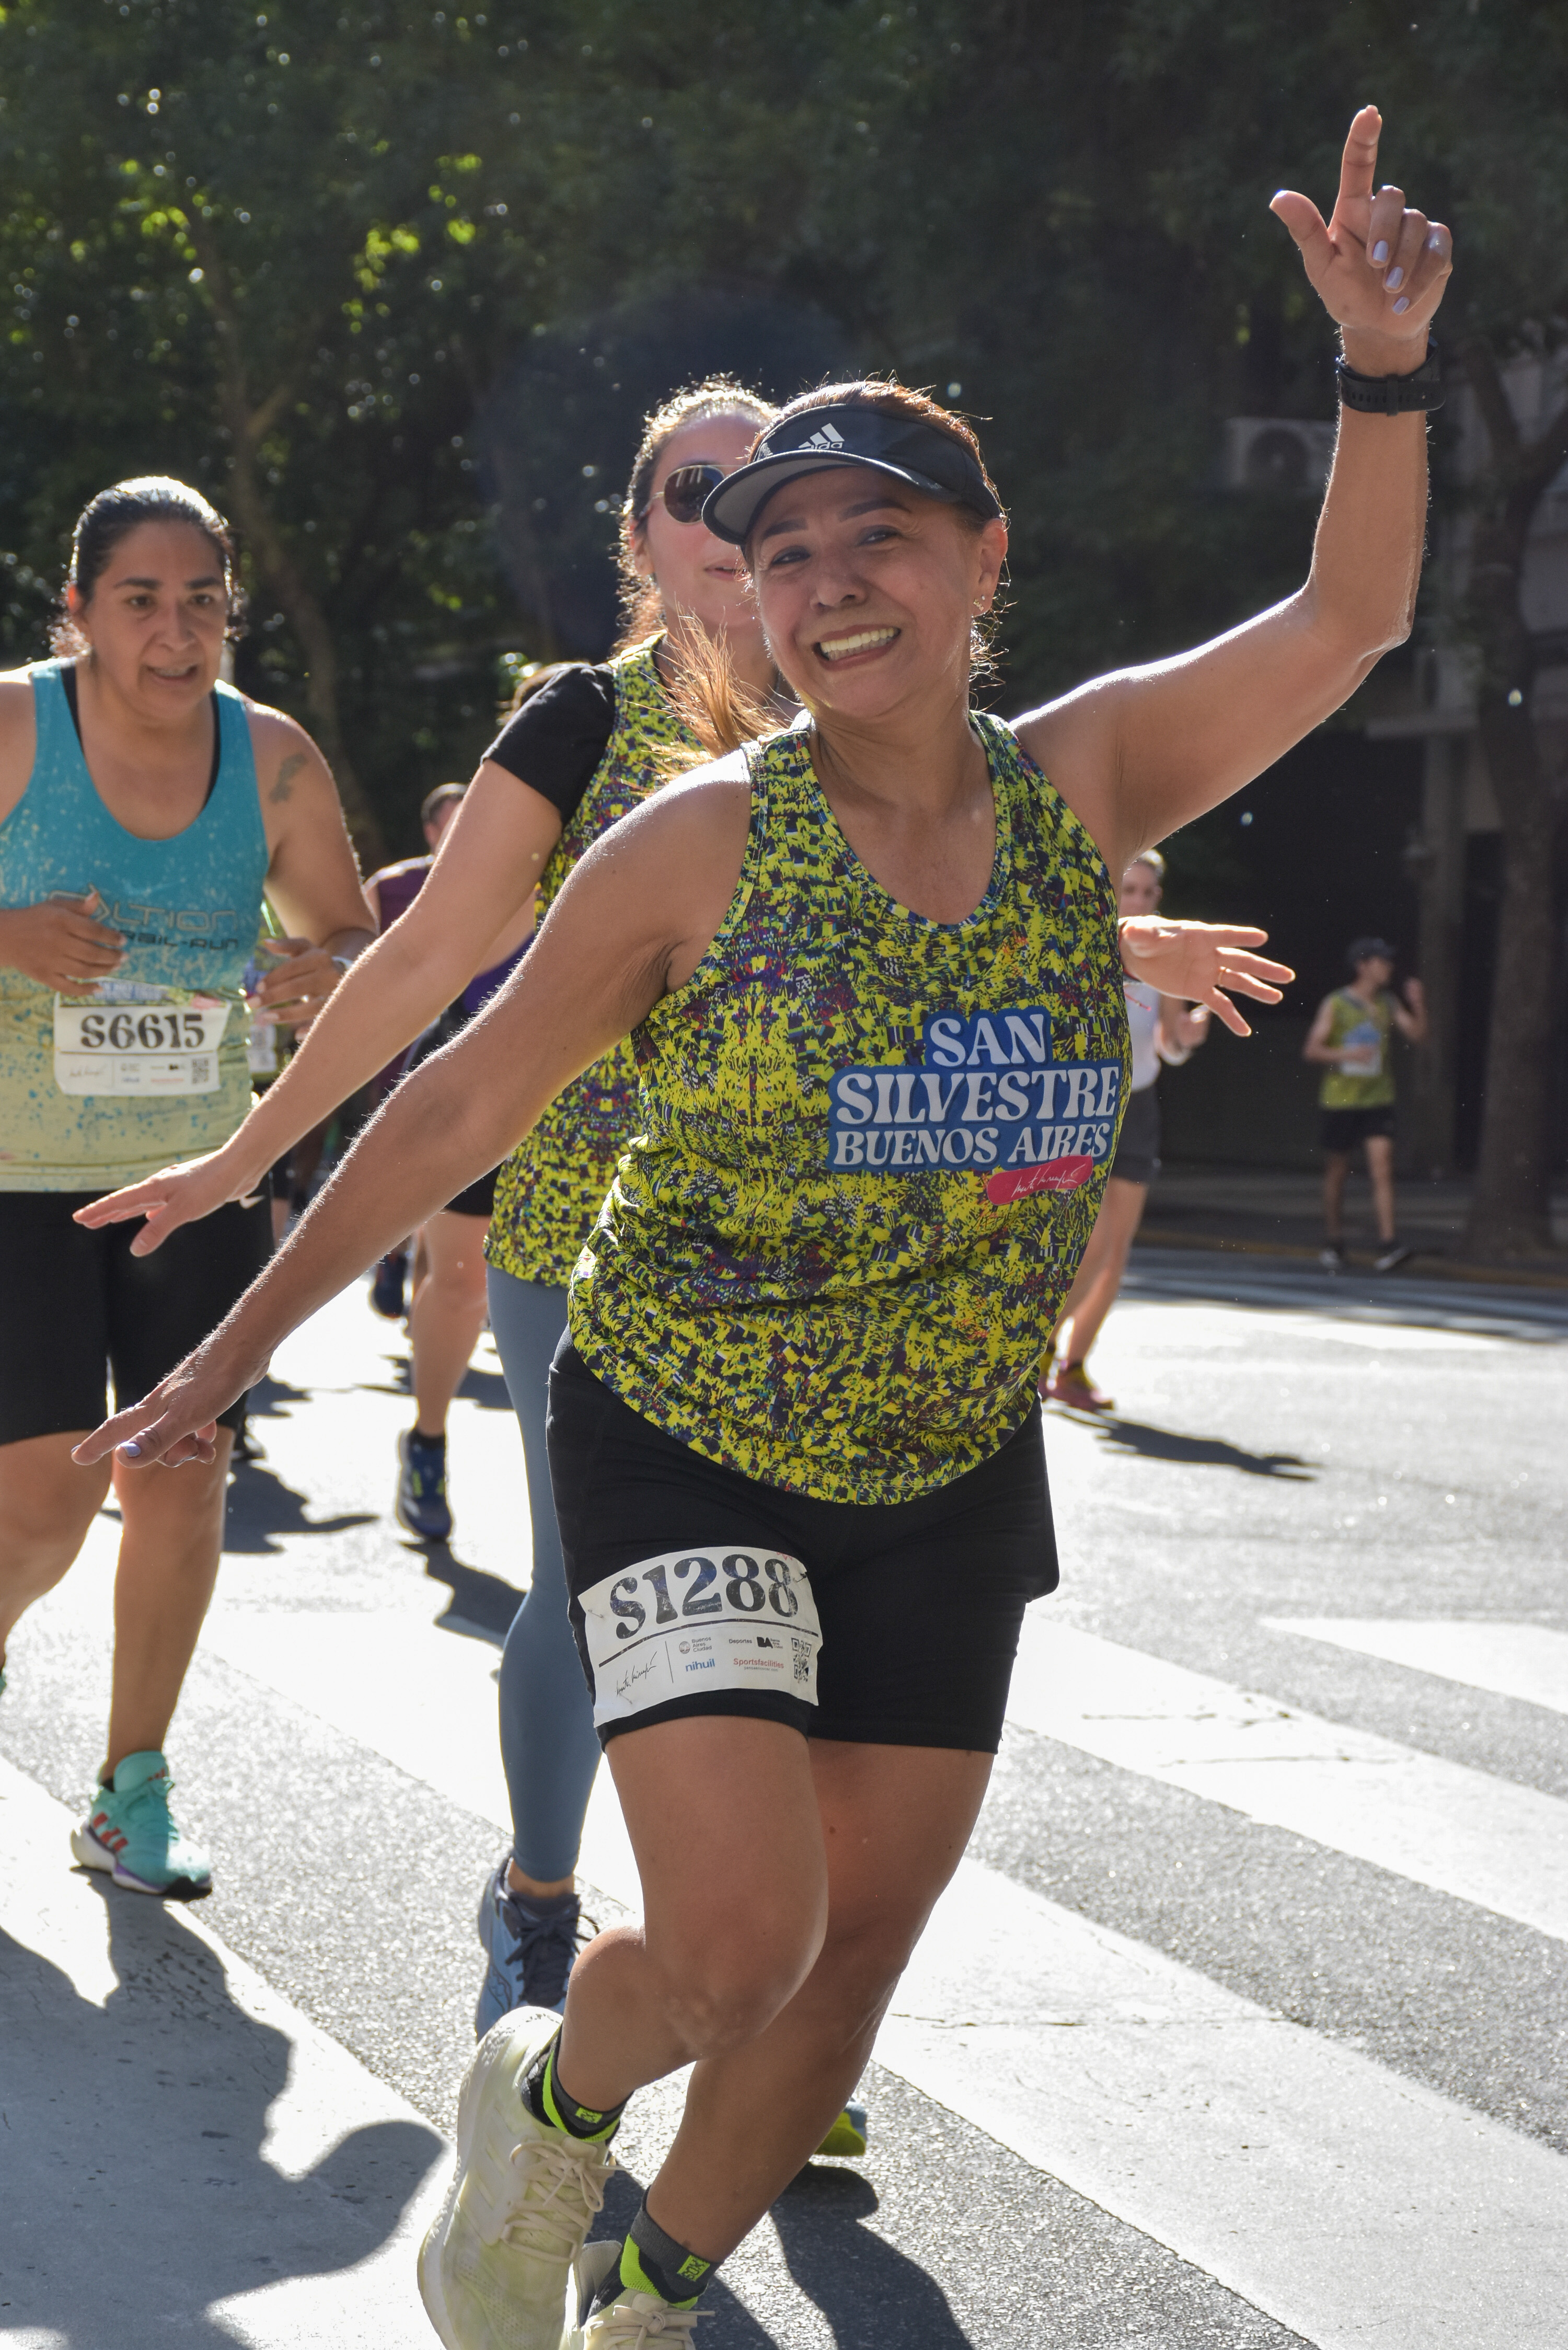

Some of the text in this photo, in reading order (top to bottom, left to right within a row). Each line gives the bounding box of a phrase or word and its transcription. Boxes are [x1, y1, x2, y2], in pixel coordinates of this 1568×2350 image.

[81, 1014, 205, 1049] S6615
[930, 1014, 1046, 1067] SAN
[836, 1066, 1119, 1124] SILVESTRE
[833, 1122, 1111, 1165] BUENOS AIRES
[609, 1553, 799, 1639] S1288
[685, 1658, 715, 1672] nihuil
[733, 1658, 784, 1668] Sportsfacilities
